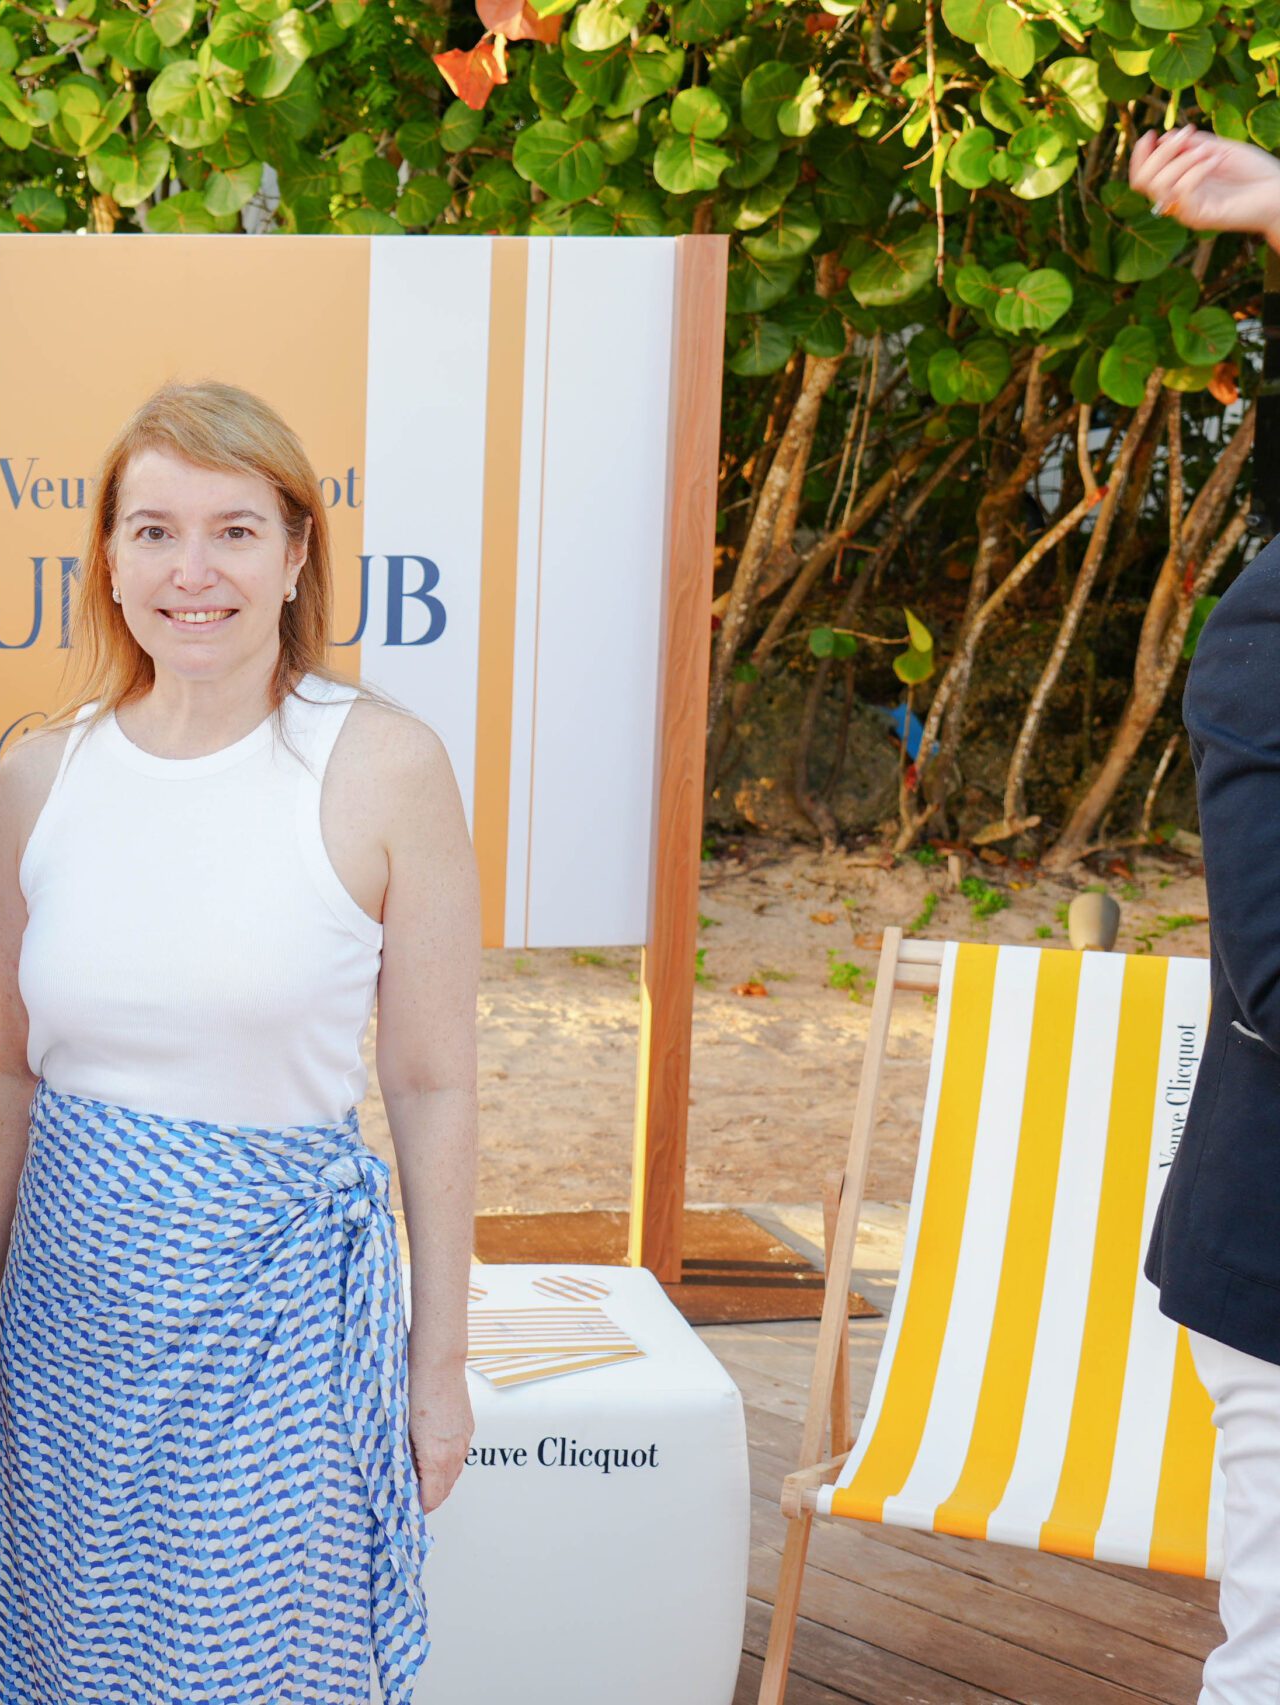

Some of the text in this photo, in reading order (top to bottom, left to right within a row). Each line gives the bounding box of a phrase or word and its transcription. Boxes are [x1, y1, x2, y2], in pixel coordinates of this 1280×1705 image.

[1164, 1022, 1200, 1107] Clicquot
[463, 1436, 661, 1475] euve Clicquot
